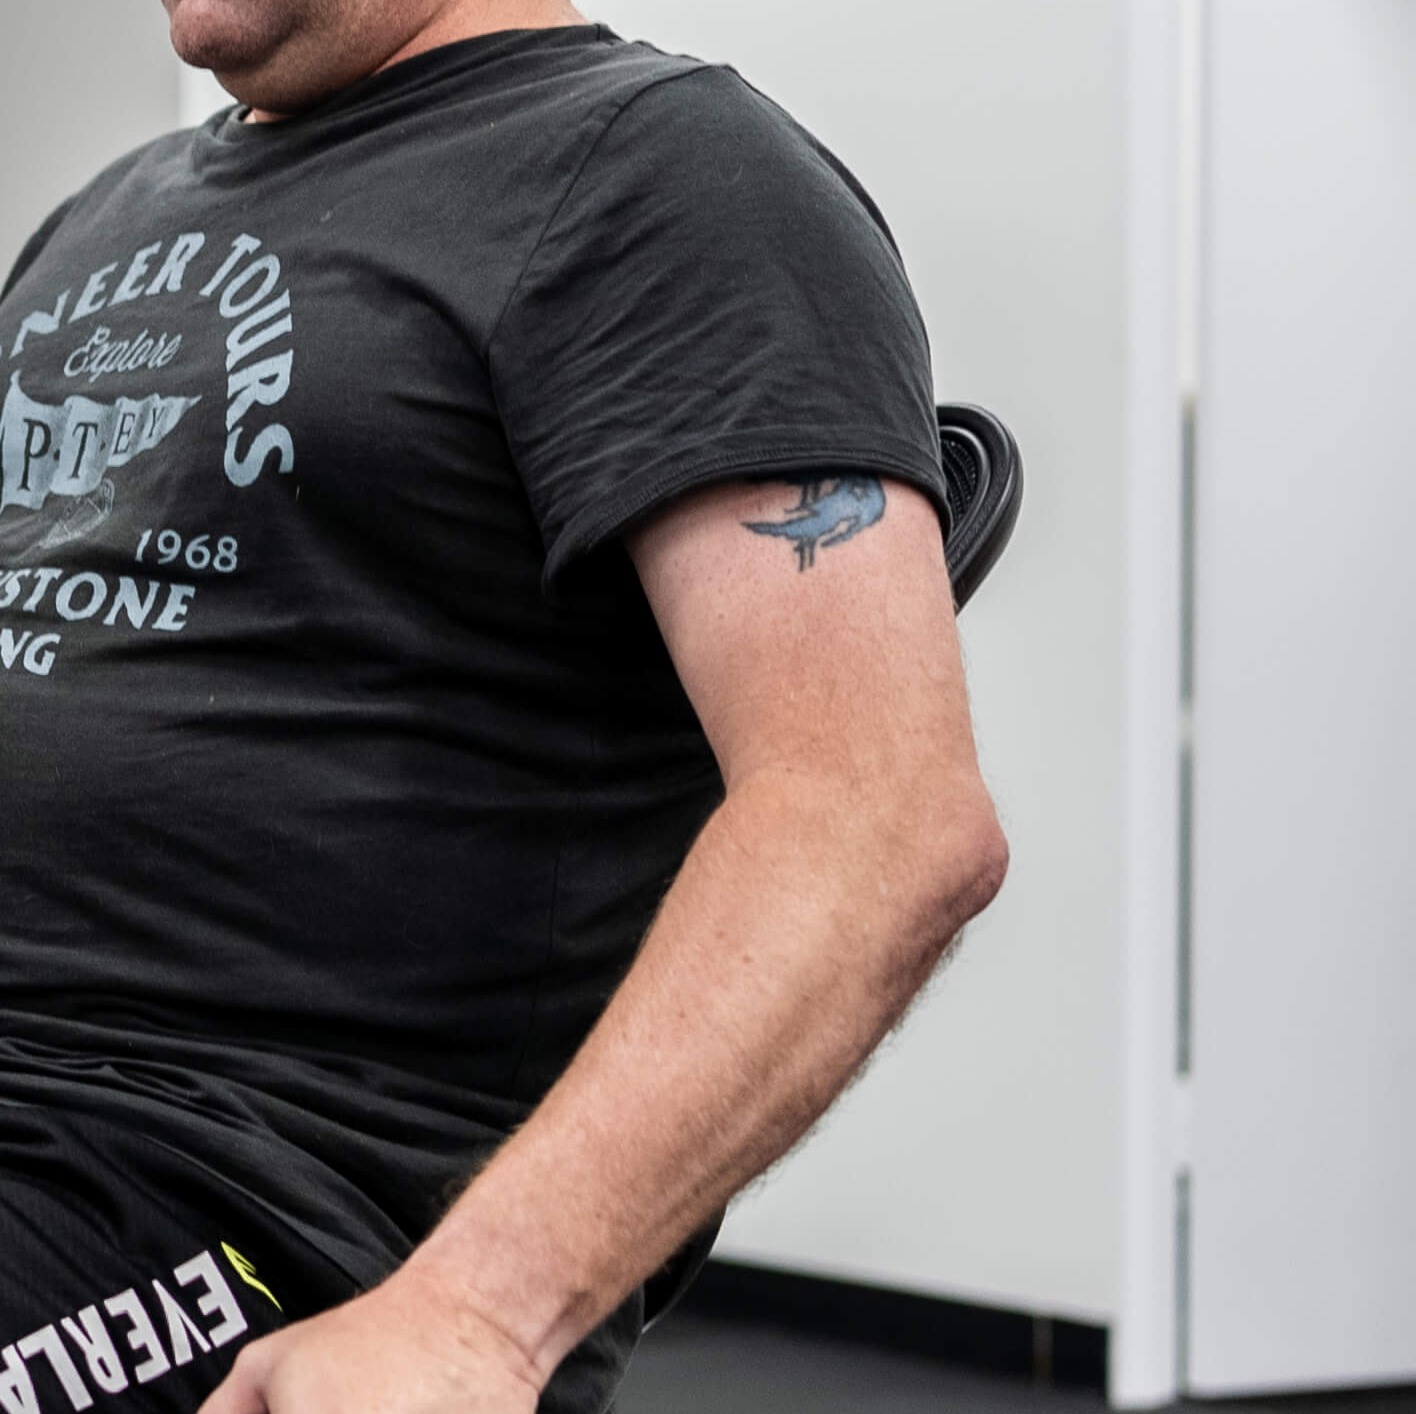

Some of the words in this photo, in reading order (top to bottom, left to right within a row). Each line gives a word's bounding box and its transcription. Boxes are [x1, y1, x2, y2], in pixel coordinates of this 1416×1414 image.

[63, 325, 183, 383] Explore
[198, 233, 295, 487] TOURS
[134, 528, 239, 573] 1968
